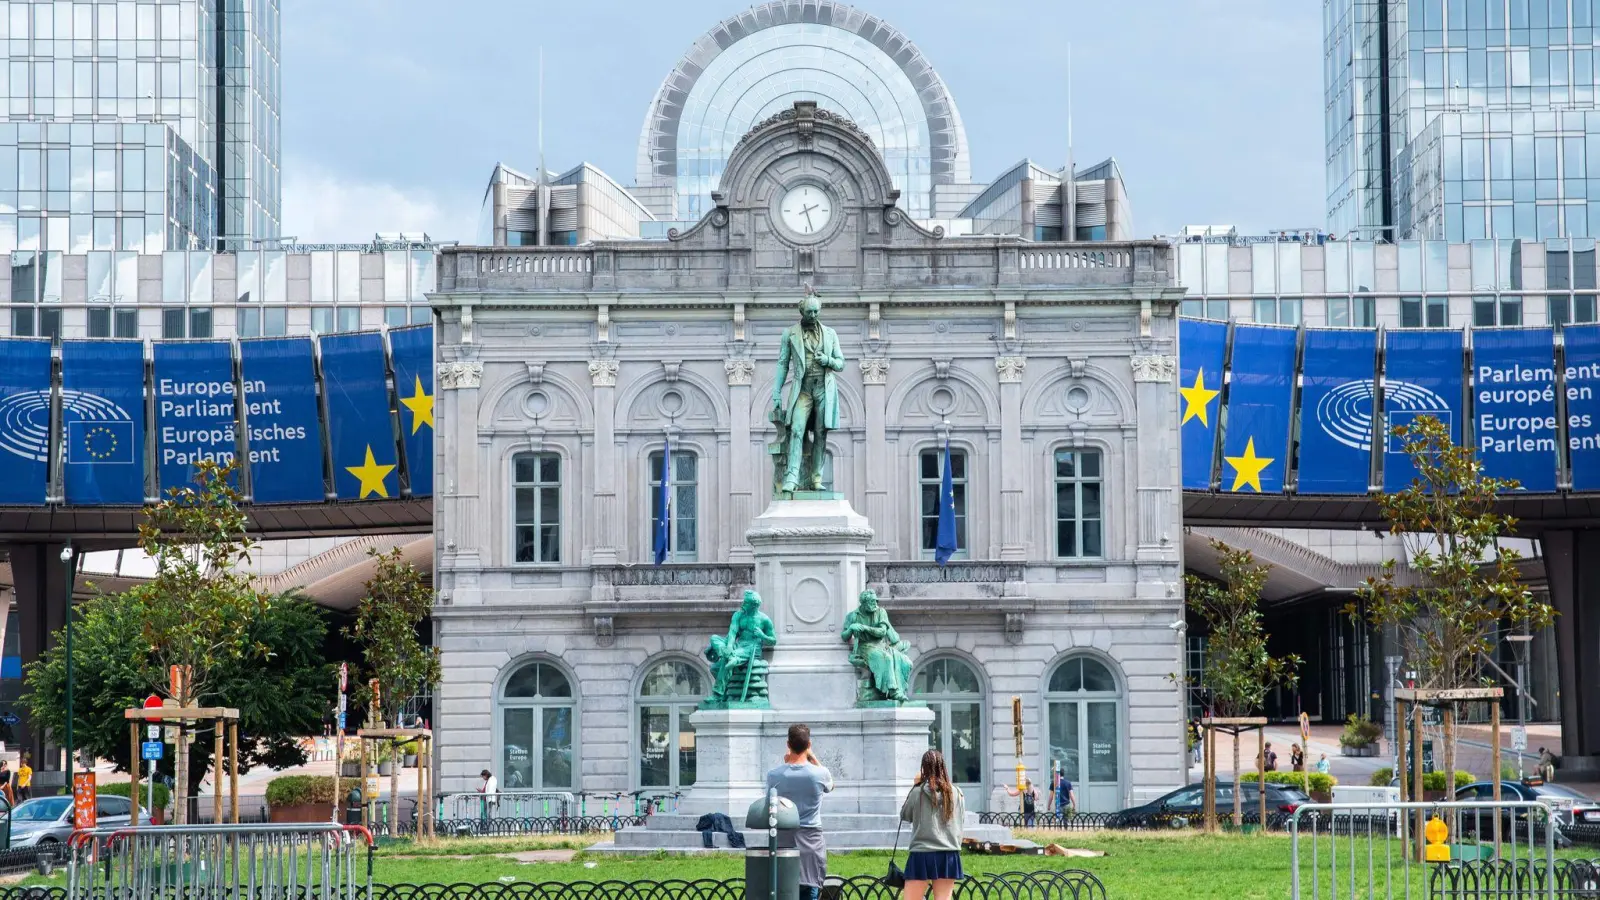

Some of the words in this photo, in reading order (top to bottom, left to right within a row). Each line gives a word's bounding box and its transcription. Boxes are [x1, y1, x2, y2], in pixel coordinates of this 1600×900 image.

[160, 379, 266, 398] European
[1479, 384, 1592, 406] européen
[161, 399, 282, 418] Parliament
[1480, 414, 1592, 433] Europees
[162, 423, 306, 446] Europäisches
[163, 447, 281, 465] Parlament
